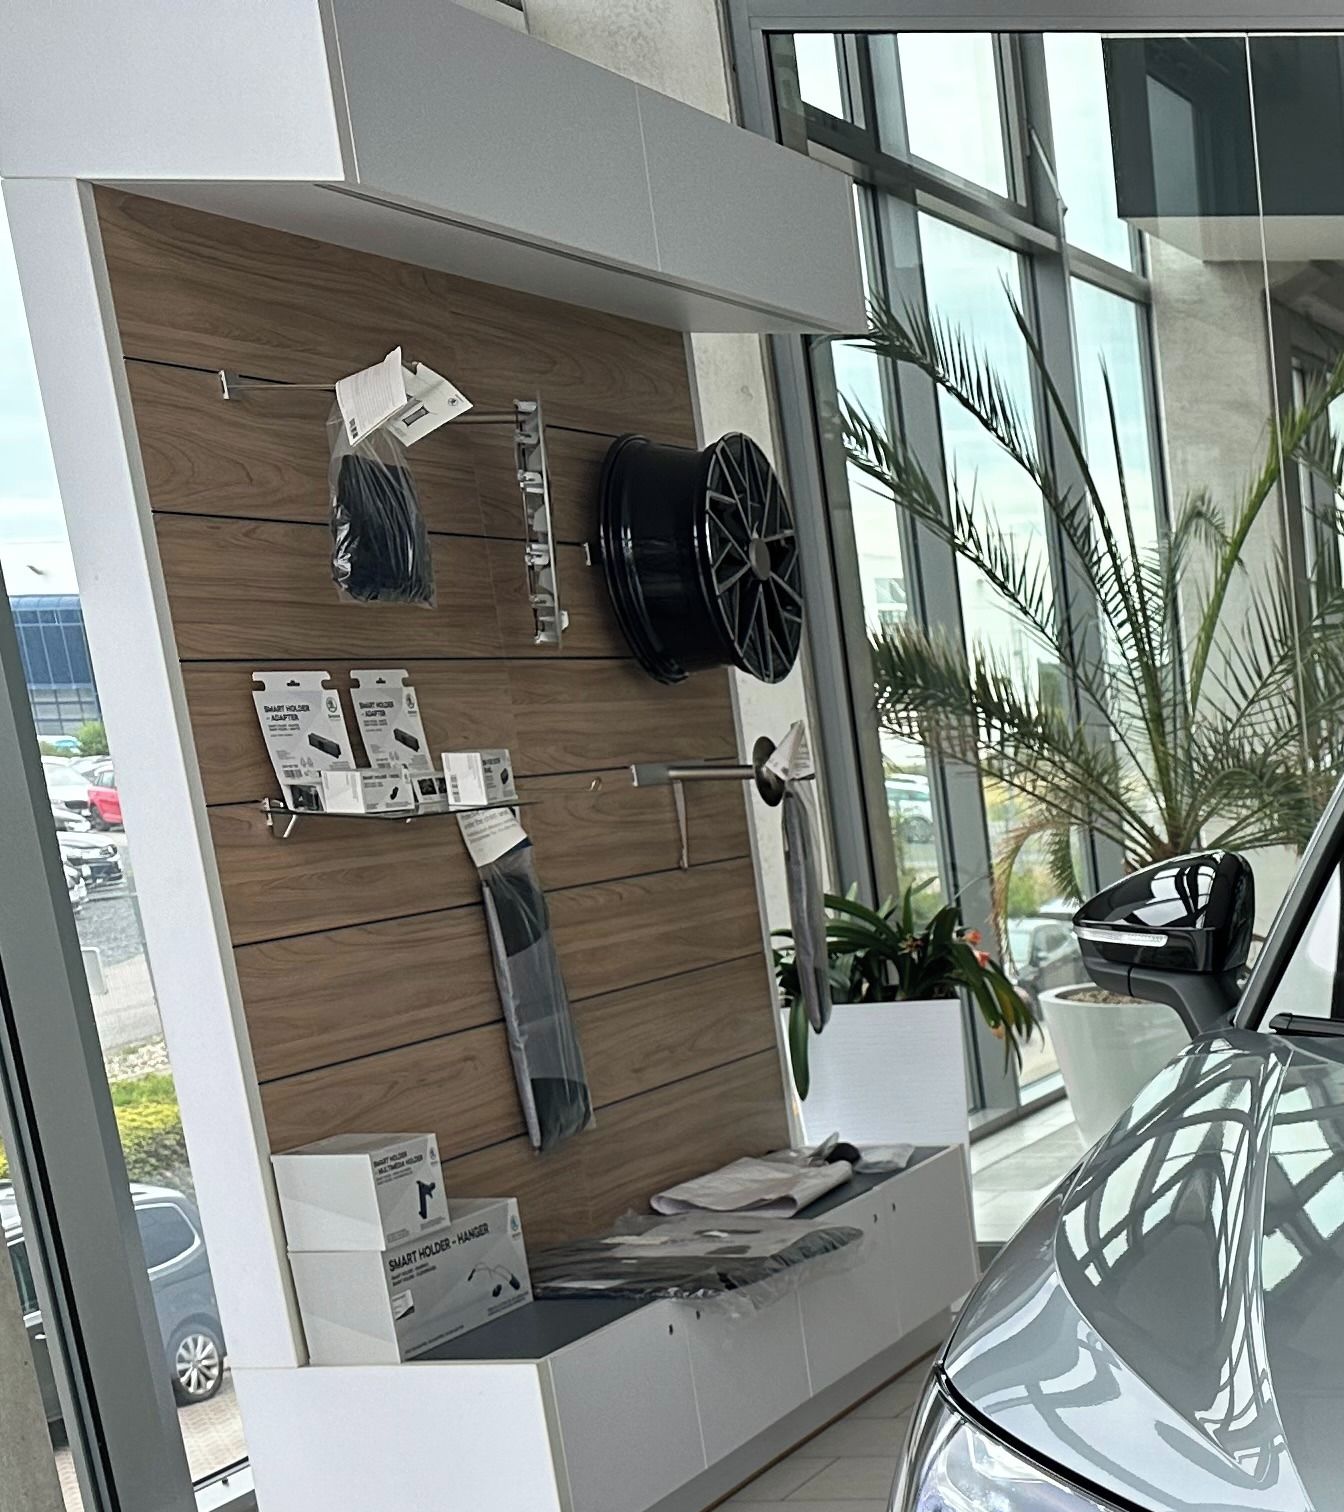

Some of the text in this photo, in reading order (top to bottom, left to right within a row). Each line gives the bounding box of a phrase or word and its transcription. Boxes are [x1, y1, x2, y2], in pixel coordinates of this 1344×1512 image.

[263, 704, 310, 713] SMART HOLDER
[271, 713, 299, 721] ADAPTER
[388, 1249, 418, 1272] SMART
[419, 1237, 452, 1260] HOLDER
[457, 1222, 490, 1245] HANGER
